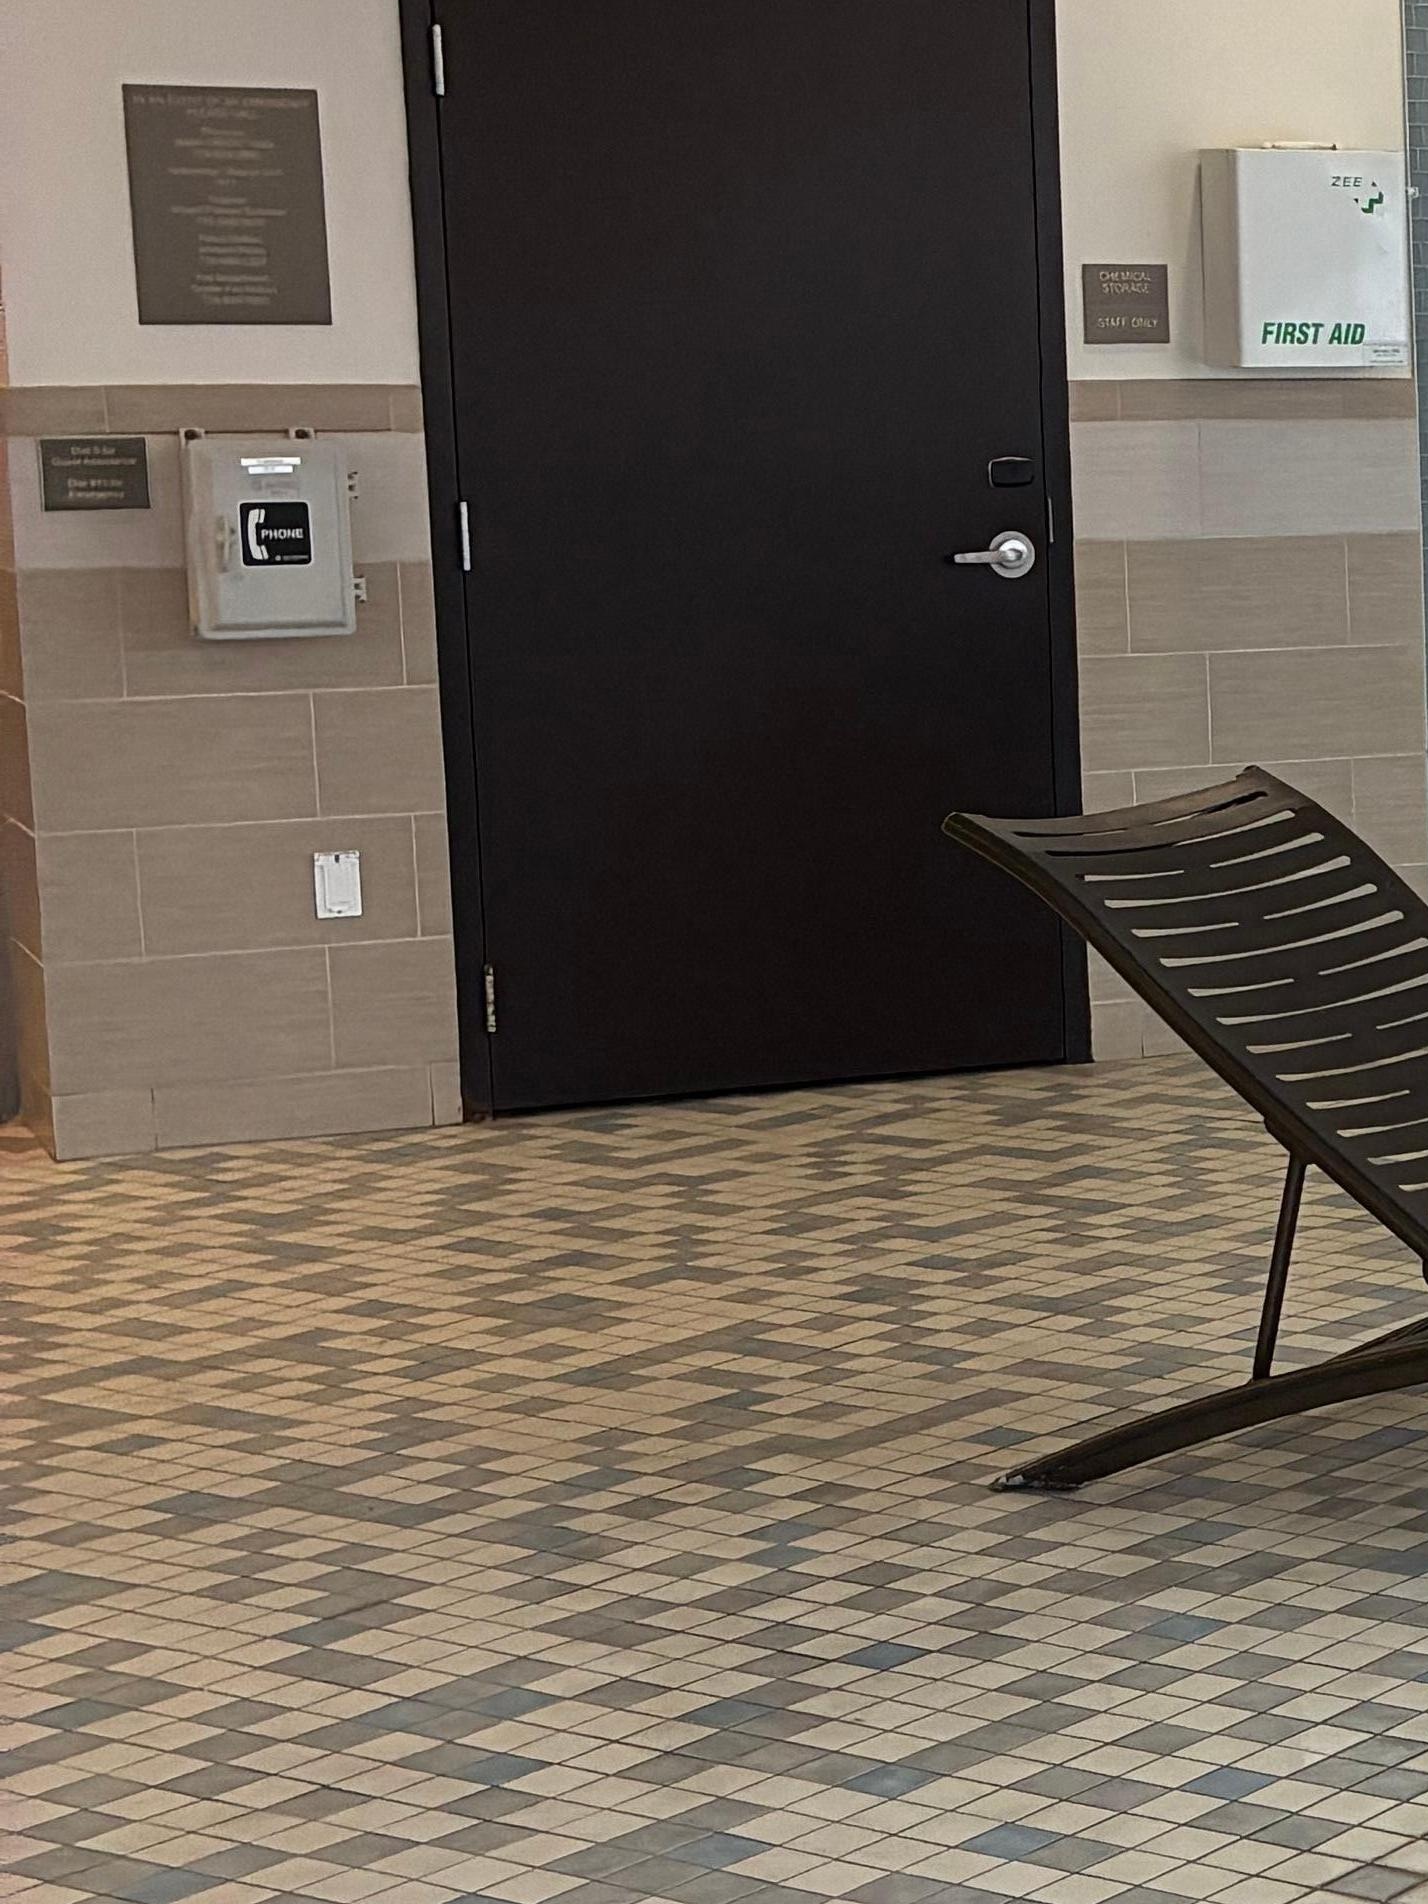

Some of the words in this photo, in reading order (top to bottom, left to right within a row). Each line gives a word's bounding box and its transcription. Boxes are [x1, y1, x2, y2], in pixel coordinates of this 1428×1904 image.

[1331, 176, 1363, 187] ZEE
[1261, 322, 1324, 345] FIRST
[1328, 323, 1366, 345] AID
[261, 528, 304, 539] PHONE
